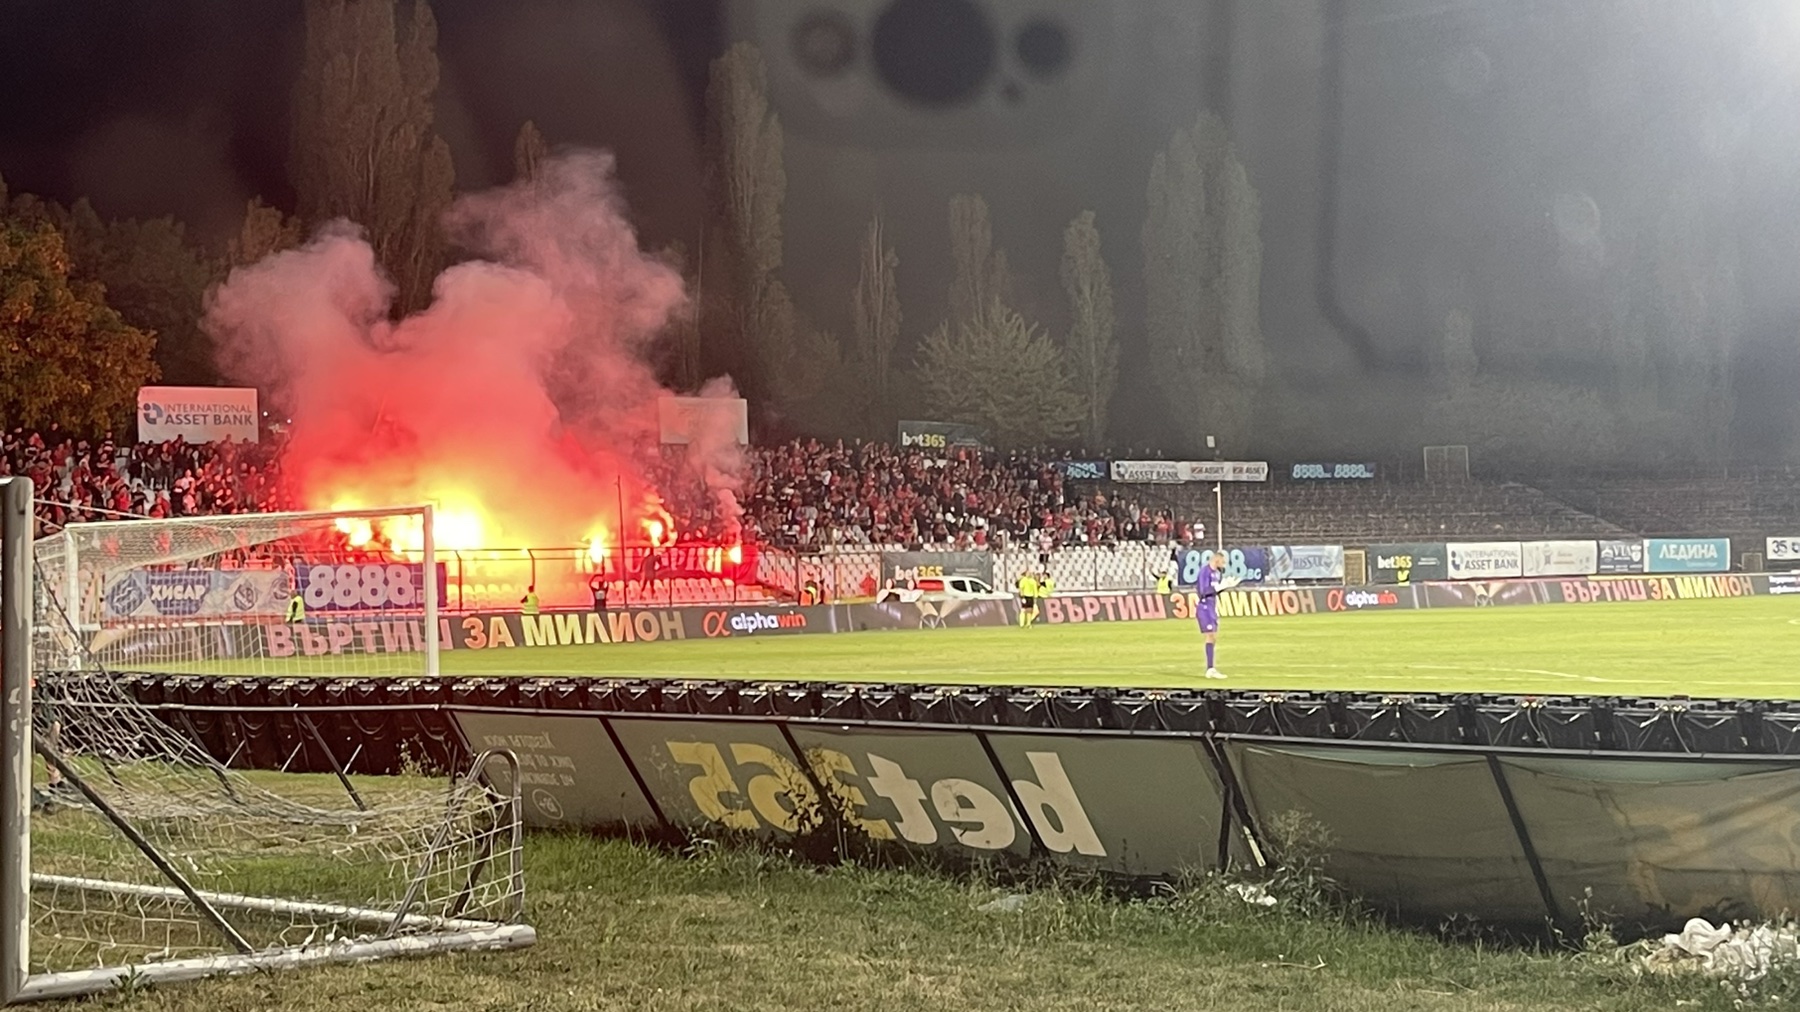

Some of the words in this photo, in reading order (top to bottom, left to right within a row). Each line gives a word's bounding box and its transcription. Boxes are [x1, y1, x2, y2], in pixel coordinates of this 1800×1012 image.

[164, 403, 252, 414] INTERNATIONAL
[164, 414, 209, 426] ASSET
[213, 414, 253, 426] BANK
[1128, 470, 1155, 480] ASSET
[1660, 544, 1718, 560] ЛЕДИНА
[1772, 540, 1788, 554] 35
[1377, 555, 1412, 568] bet365
[1464, 560, 1491, 570] ASSET
[1494, 559, 1519, 569] BANK
[895, 565, 944, 580] bet365
[150, 584, 206, 601] ХИСАР
[1560, 580, 1647, 603] ВЪРТИШ
[1648, 578, 1676, 601] ЗА
[1674, 576, 1755, 599] МИЛИОН
[1044, 594, 1167, 623] ВЪРТИШ
[1216, 590, 1317, 617] МИЛИОН
[1346, 590, 1398, 608] alphawin
[731, 610, 806, 633] alphawin
[265, 619, 453, 657] ВЪРТИШ
[463, 617, 515, 649] ЗА
[521, 611, 685, 646] МИЛИОН
